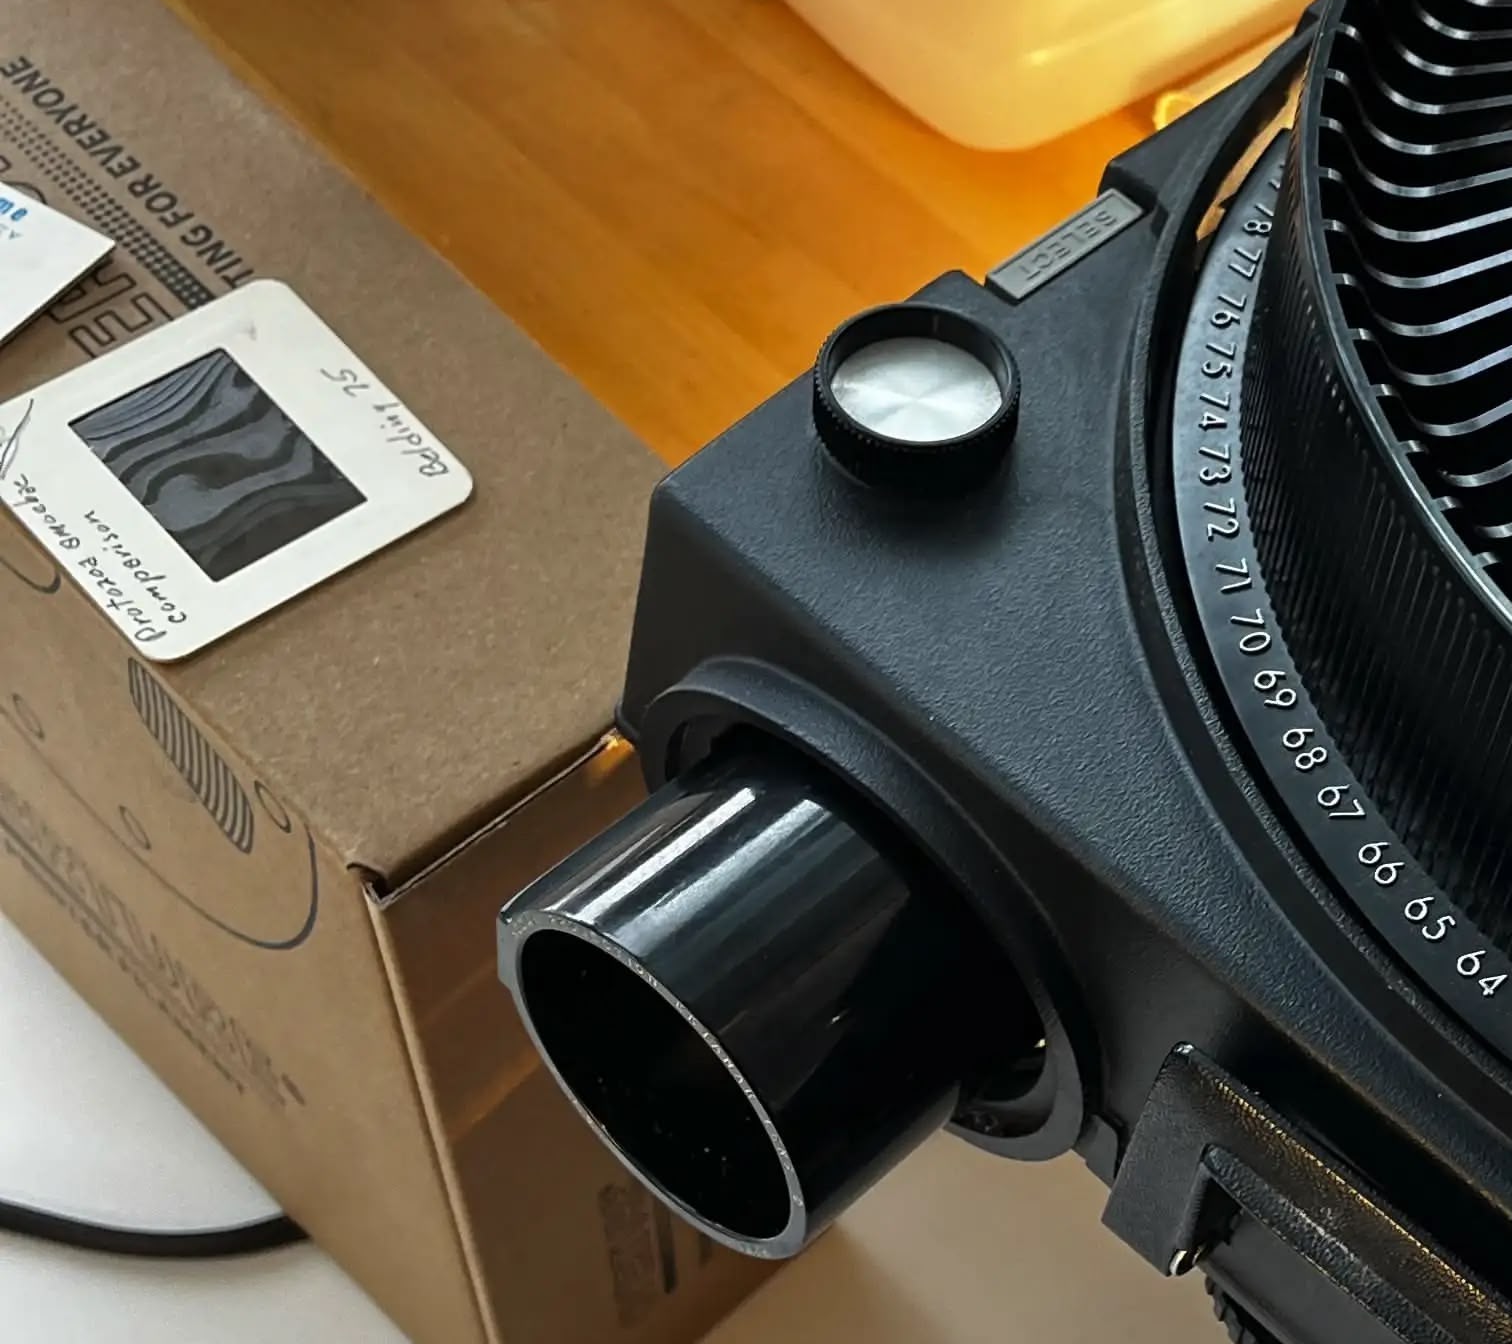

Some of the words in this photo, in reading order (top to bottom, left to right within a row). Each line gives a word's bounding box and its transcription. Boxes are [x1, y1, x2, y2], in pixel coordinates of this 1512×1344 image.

[0, 55, 141, 180] EVERYONE
[128, 173, 194, 229] FOR
[1019, 210, 1118, 281] SELECT
[1230, 247, 1262, 279] 77
[1211, 294, 1247, 327] 76
[1202, 342, 1235, 379] 75
[1199, 392, 1231, 429] 74
[1199, 441, 1232, 484] 73
[1203, 497, 1240, 540] 72
[84, 509, 188, 624] comparison
[1215, 557, 1251, 591] 71
[1230, 608, 1271, 652] 70
[1253, 669, 1297, 707] 69
[1283, 725, 1327, 769] 68
[1317, 784, 1365, 816] 67
[1358, 842, 1405, 884] 66
[1404, 897, 1455, 939] 65
[1457, 950, 1508, 995] 64
